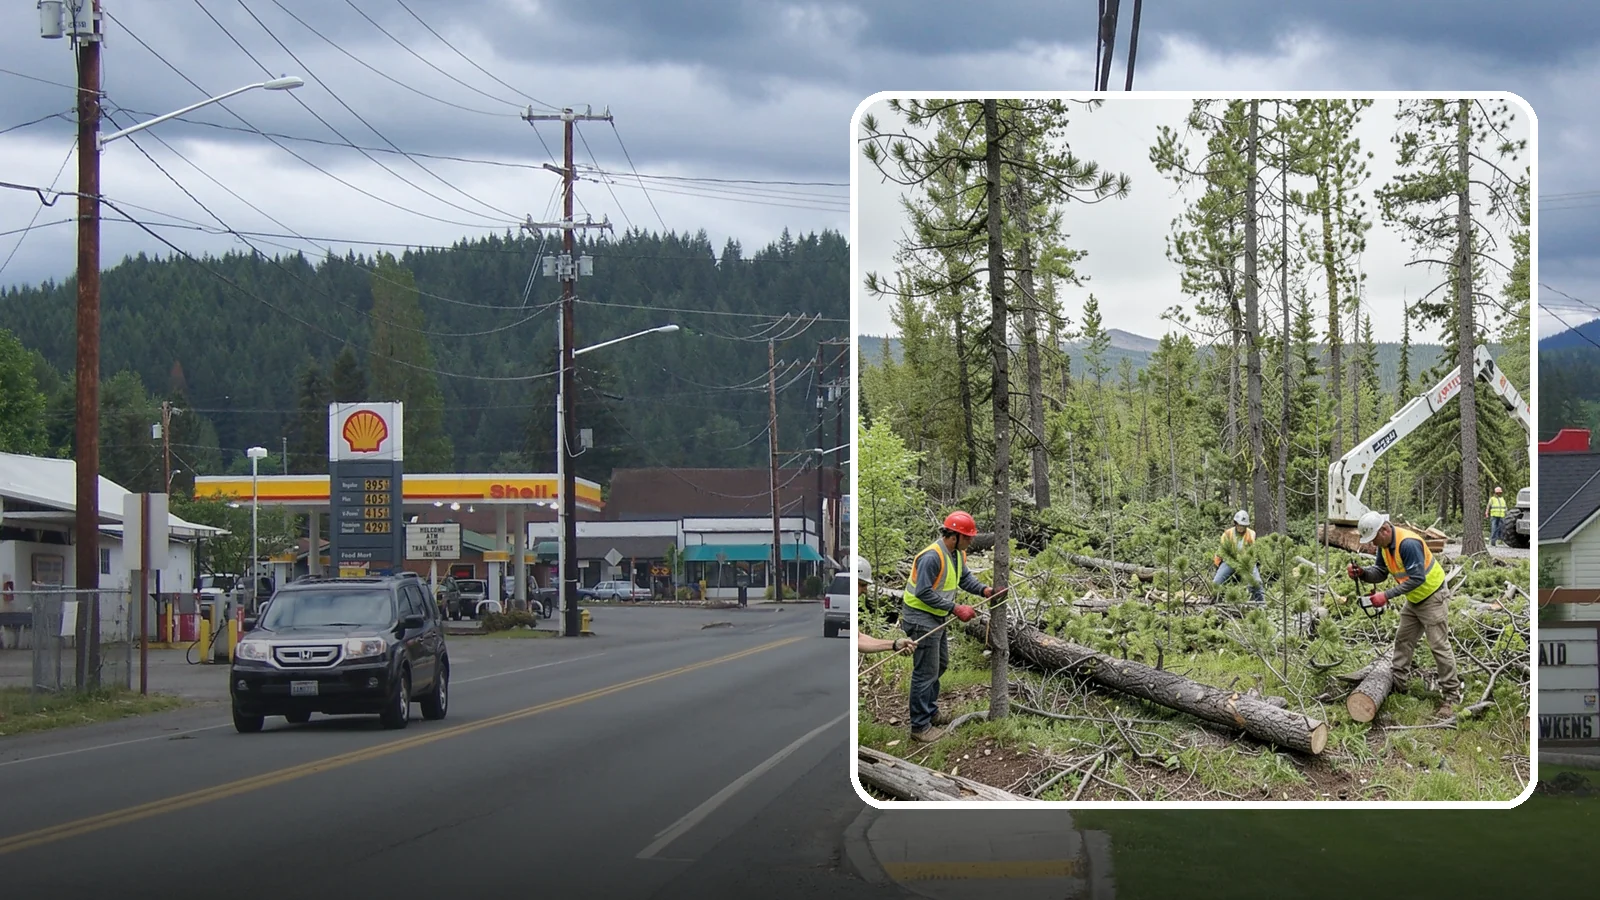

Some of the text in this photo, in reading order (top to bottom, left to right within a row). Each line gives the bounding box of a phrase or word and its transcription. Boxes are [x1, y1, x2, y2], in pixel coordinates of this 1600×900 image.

[366, 480, 384, 490] 395
[490, 484, 548, 499] Shell
[366, 494, 384, 504] 405
[366, 508, 384, 518] 415
[366, 522, 384, 532] 429
[1538, 642, 1566, 666] AID
